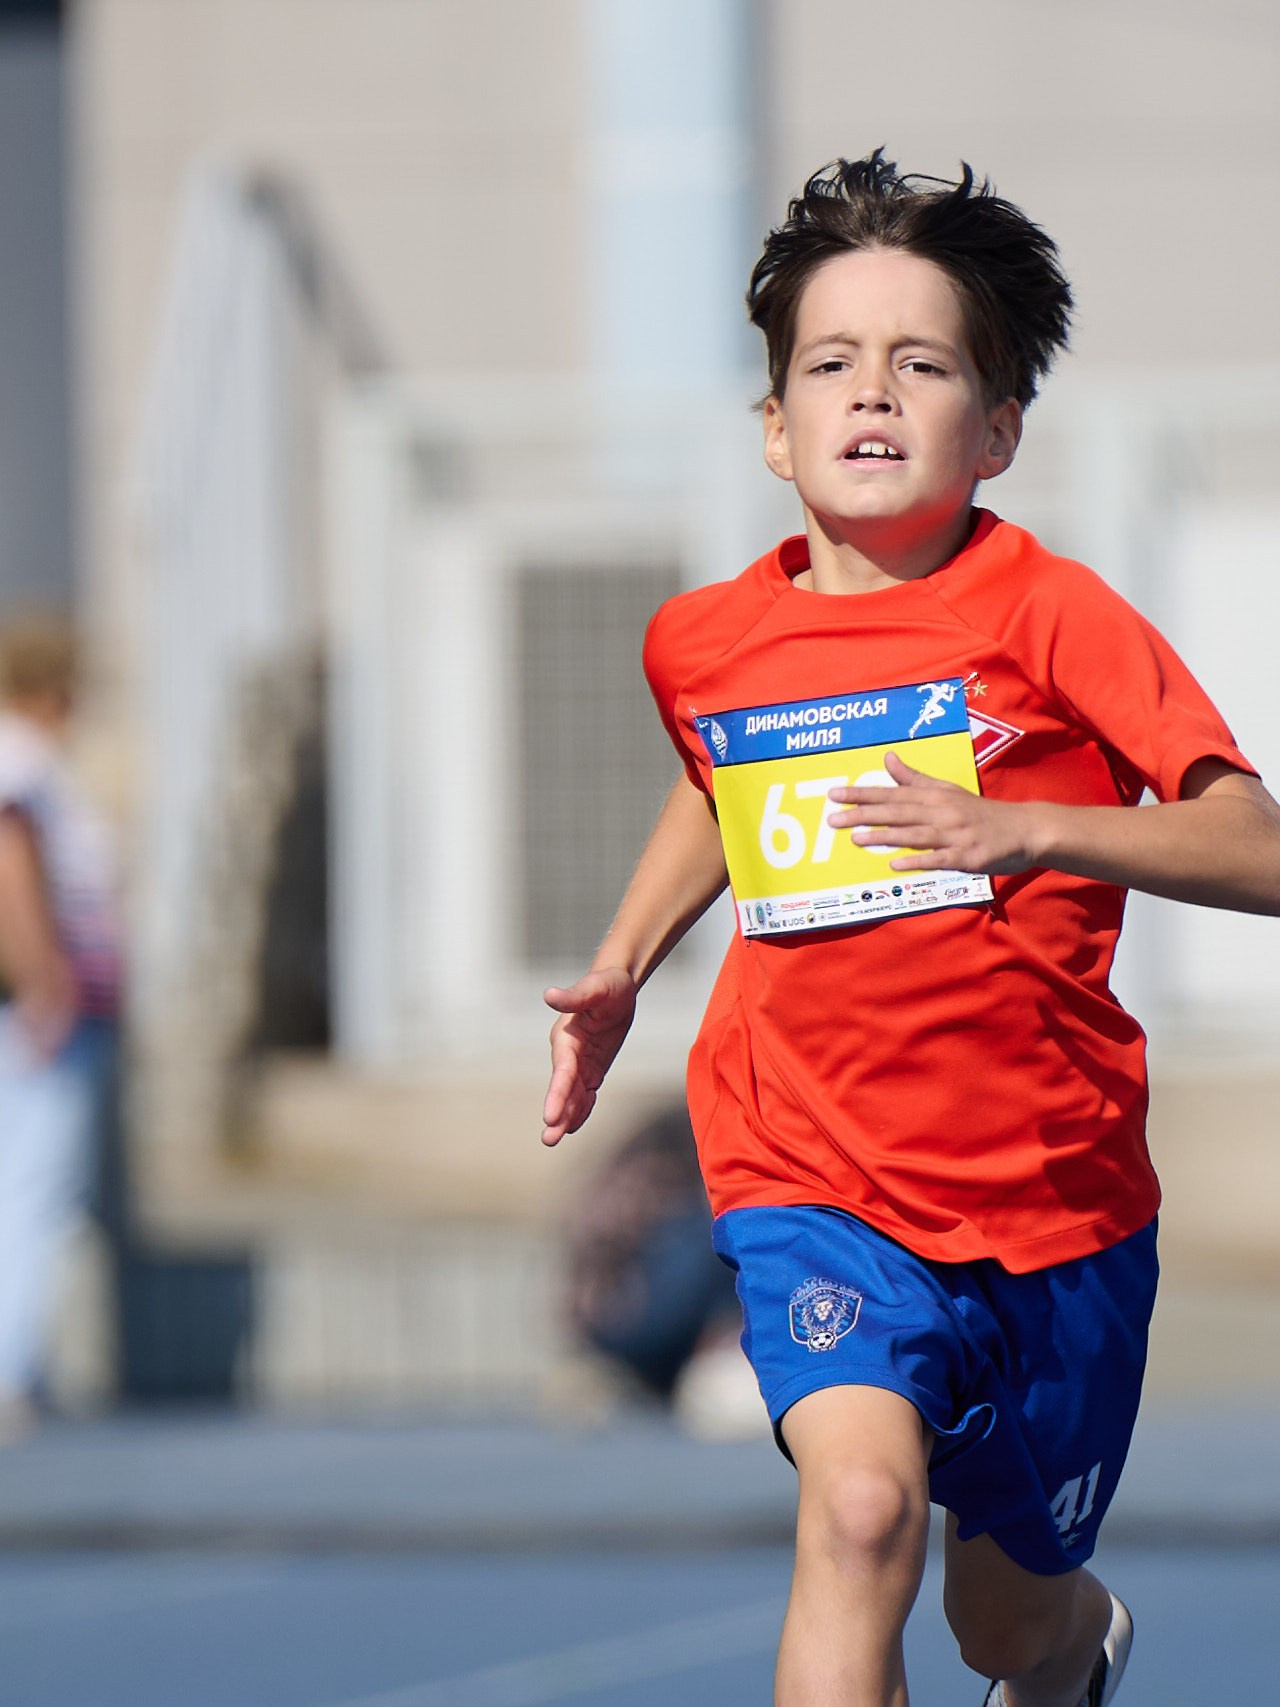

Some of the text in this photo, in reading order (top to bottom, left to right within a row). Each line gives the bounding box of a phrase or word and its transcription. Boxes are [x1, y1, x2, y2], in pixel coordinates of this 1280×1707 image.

[745, 698, 888, 736] ДИНАМОВСКАЯ
[786, 727, 841, 751] МИЛЯ
[1049, 1461, 1102, 1533] 41
